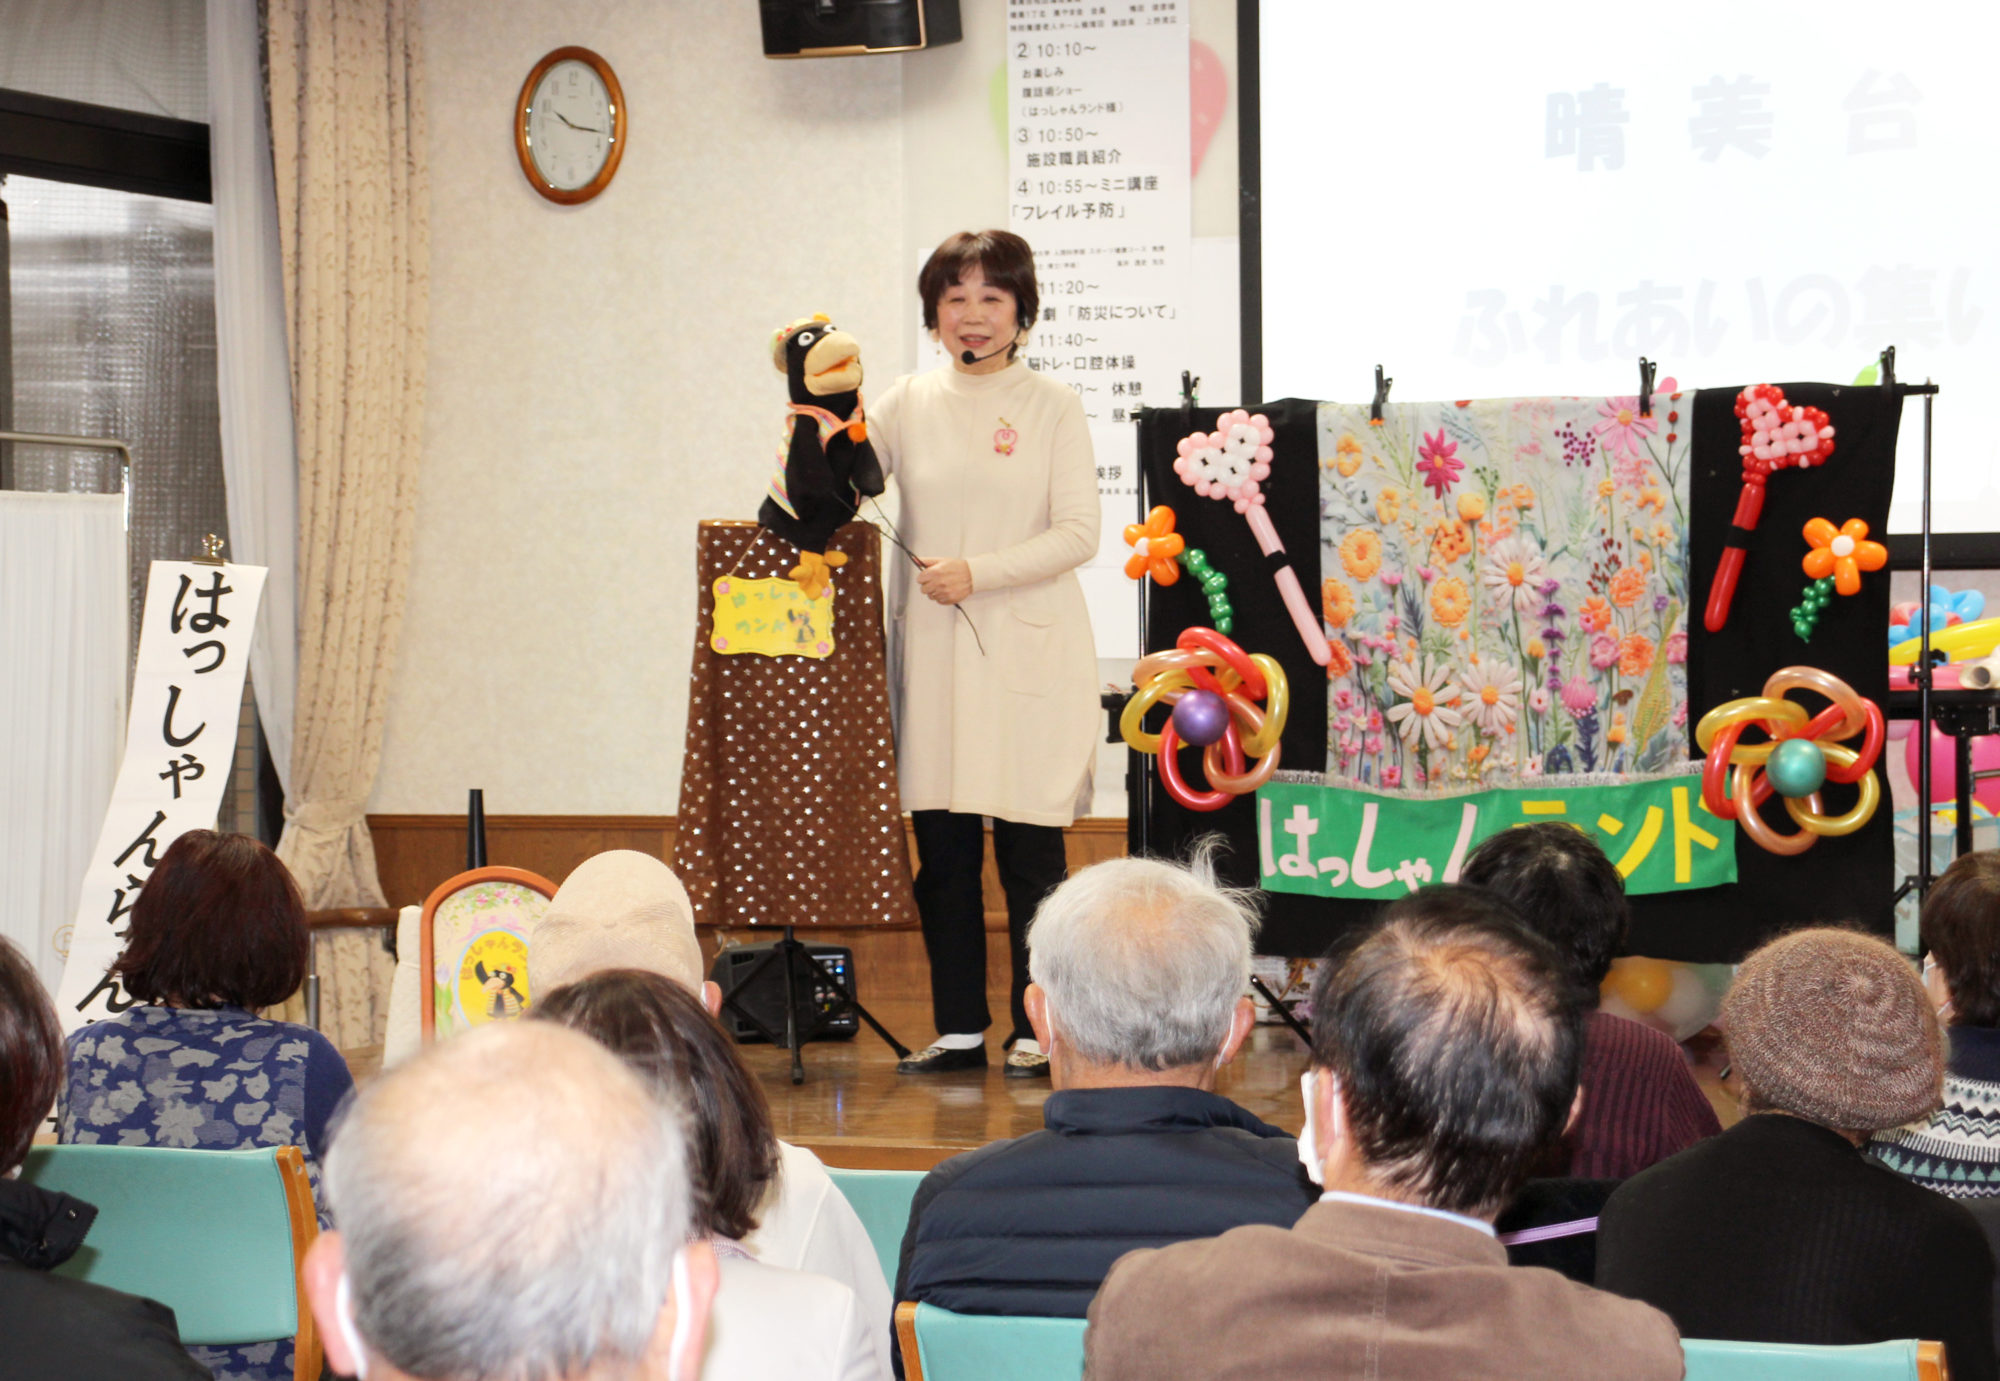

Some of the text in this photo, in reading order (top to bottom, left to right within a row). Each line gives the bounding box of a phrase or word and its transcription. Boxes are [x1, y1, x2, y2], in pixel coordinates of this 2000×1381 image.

[1022, 66, 1064, 79] お楽しみ
[1022, 85, 1083, 98] 腹話術ショー
[1026, 148, 1122, 168] 施設職員紹介
[1011, 202, 1126, 221] 「フレイル予防」
[1028, 355, 1136, 371] 脳トレ・口腔体操
[1112, 382, 1142, 396] 休憩
